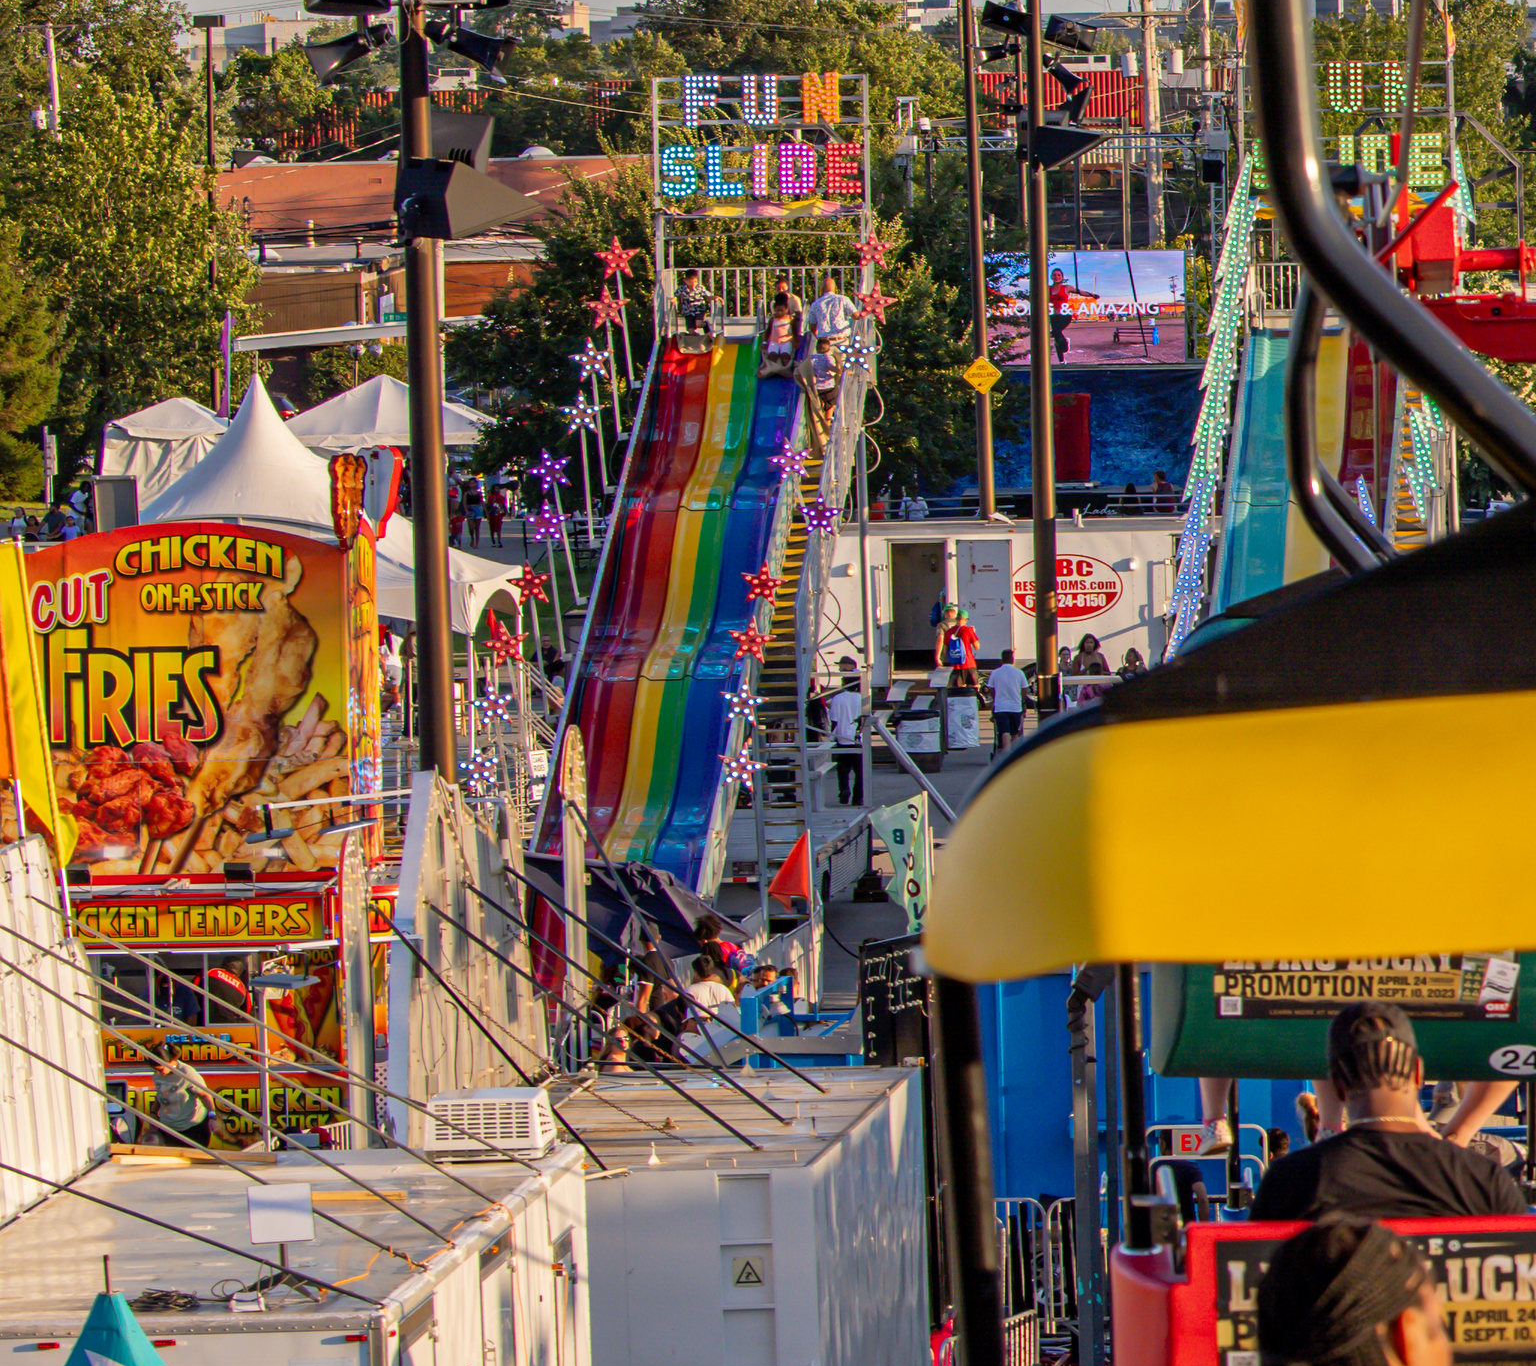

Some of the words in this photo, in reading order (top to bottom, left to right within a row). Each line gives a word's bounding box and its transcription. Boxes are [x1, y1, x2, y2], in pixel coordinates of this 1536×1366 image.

[684, 72, 841, 126] FUN
[661, 143, 861, 196] SLIDE
[1061, 303, 1073, 315] &
[1078, 302, 1160, 315] AMAZING
[116, 534, 284, 580] CHICKEN
[31, 570, 113, 632] CUT
[140, 582, 264, 612] ON-A-STICK
[47, 625, 223, 750] FRIES
[170, 902, 312, 939] TENDERS
[217, 970, 240, 987] TALLEY
[1225, 973, 1374, 998] PROMOTION
[1377, 976, 1411, 986] APRIL
[1413, 976, 1427, 986] 24
[1377, 988, 1408, 999] SEPT.
[1428, 988, 1456, 999] 2023
[1463, 1308, 1508, 1324] APRIL
[1463, 1326, 1510, 1342] SEPT.
